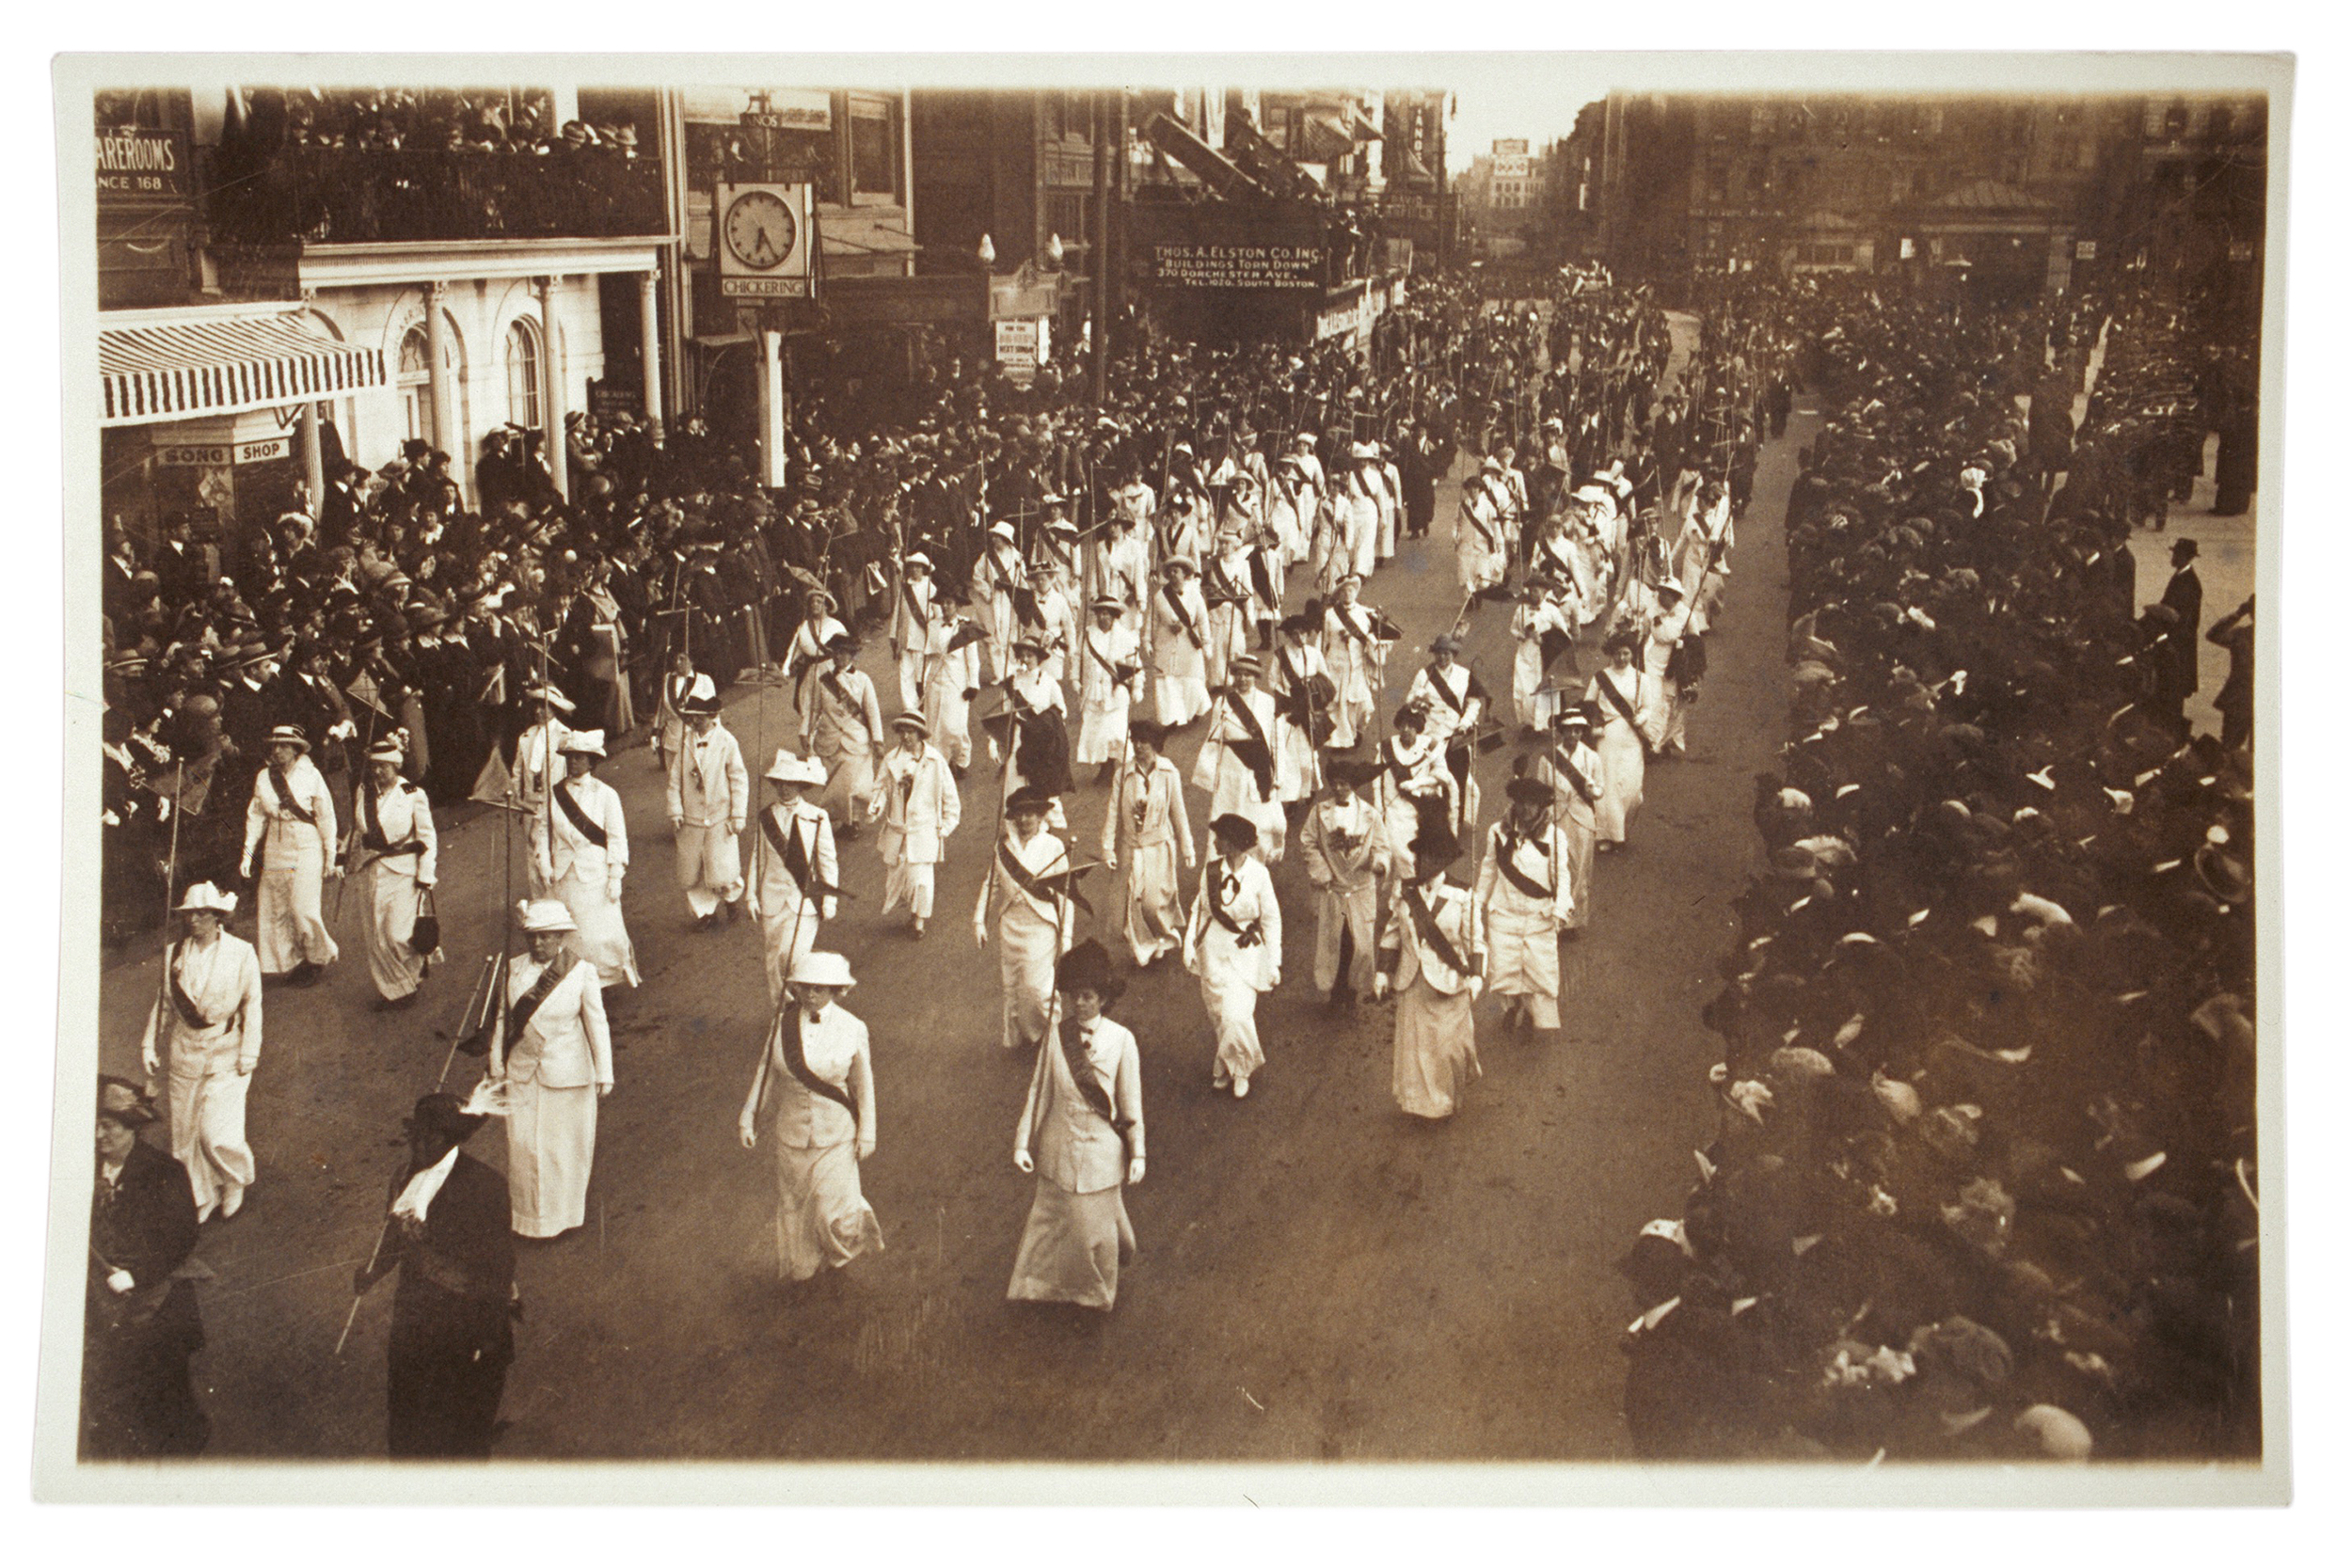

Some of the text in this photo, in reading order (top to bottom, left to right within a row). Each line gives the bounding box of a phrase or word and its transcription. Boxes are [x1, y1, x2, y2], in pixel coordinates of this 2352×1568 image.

[136, 176, 163, 190] 168
[1210, 245, 1266, 259] ELSTON
[1238, 259, 1270, 270] TORN
[1157, 267, 1298, 279] 370 DORCHESTER AVE.
[723, 280, 803, 294] CHICKERING
[1237, 278, 1270, 288] SOUTH
[165, 442, 280, 463] SONG SHOP
